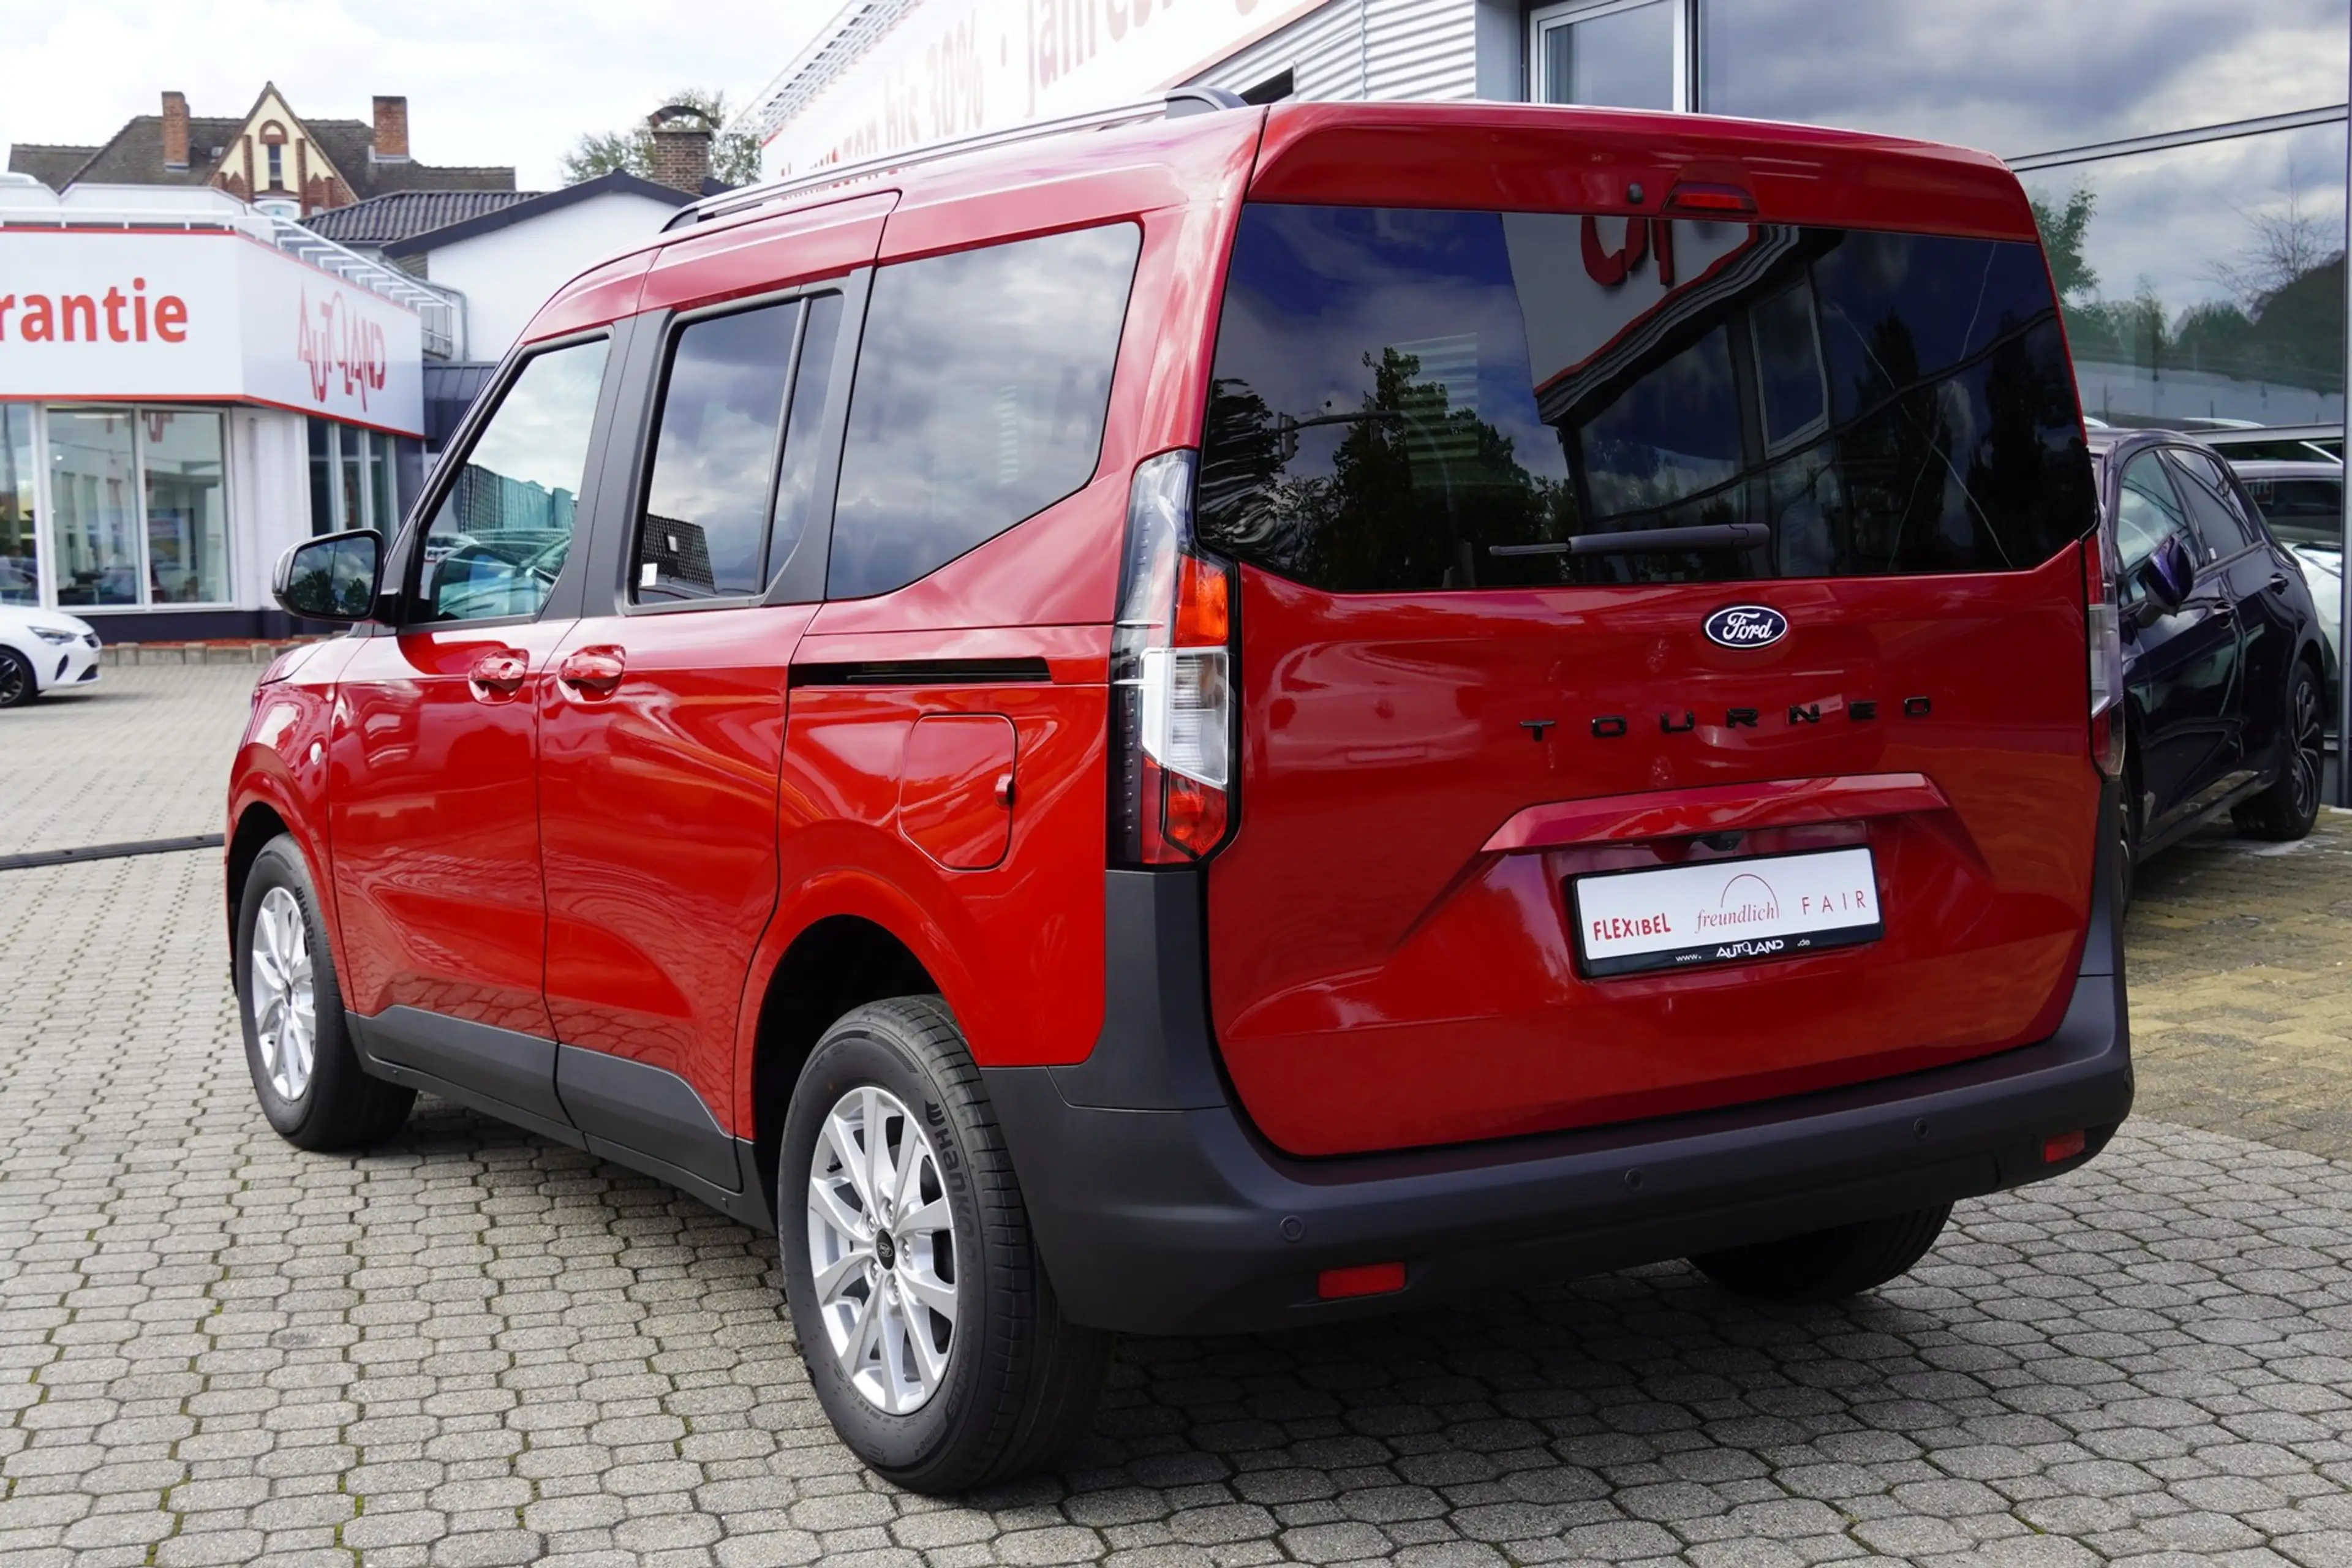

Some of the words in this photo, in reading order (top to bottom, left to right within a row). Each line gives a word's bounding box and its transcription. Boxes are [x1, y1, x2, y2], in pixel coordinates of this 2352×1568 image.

[0, 277, 187, 343] rantie
[1722, 612, 1773, 641] Ford
[1518, 696, 1932, 742] TOURNEO
[1593, 913, 1672, 941] FLEXIBEL
[1695, 902, 1775, 934] freundlich
[1801, 890, 1866, 916] FAIR
[1675, 953, 1702, 962] www.
[1716, 939, 1784, 959] AUTOLAND
[1797, 938, 1811, 947] .de
